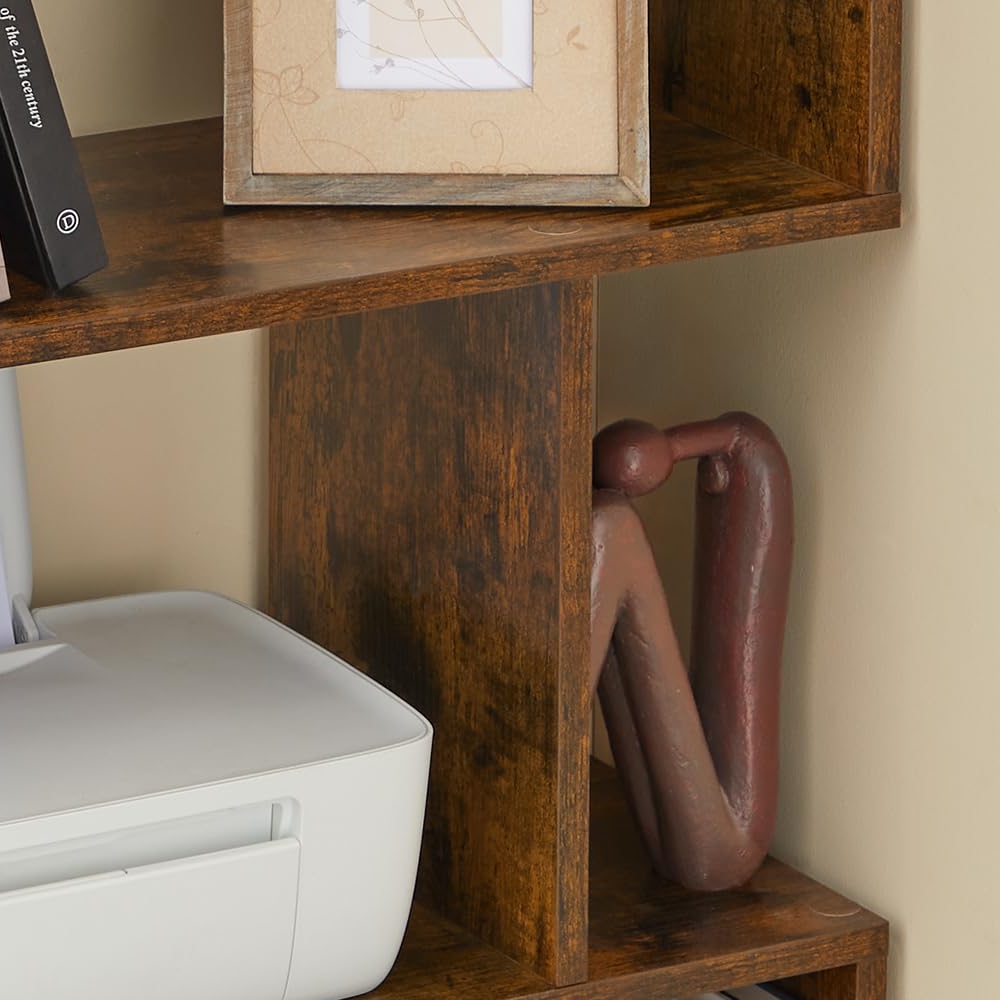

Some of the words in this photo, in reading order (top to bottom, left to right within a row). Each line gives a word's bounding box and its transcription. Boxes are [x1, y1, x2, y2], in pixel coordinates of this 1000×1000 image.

[5, 25, 20, 47] the
[11, 48, 31, 78] 21th
[21, 80, 43, 128] century
